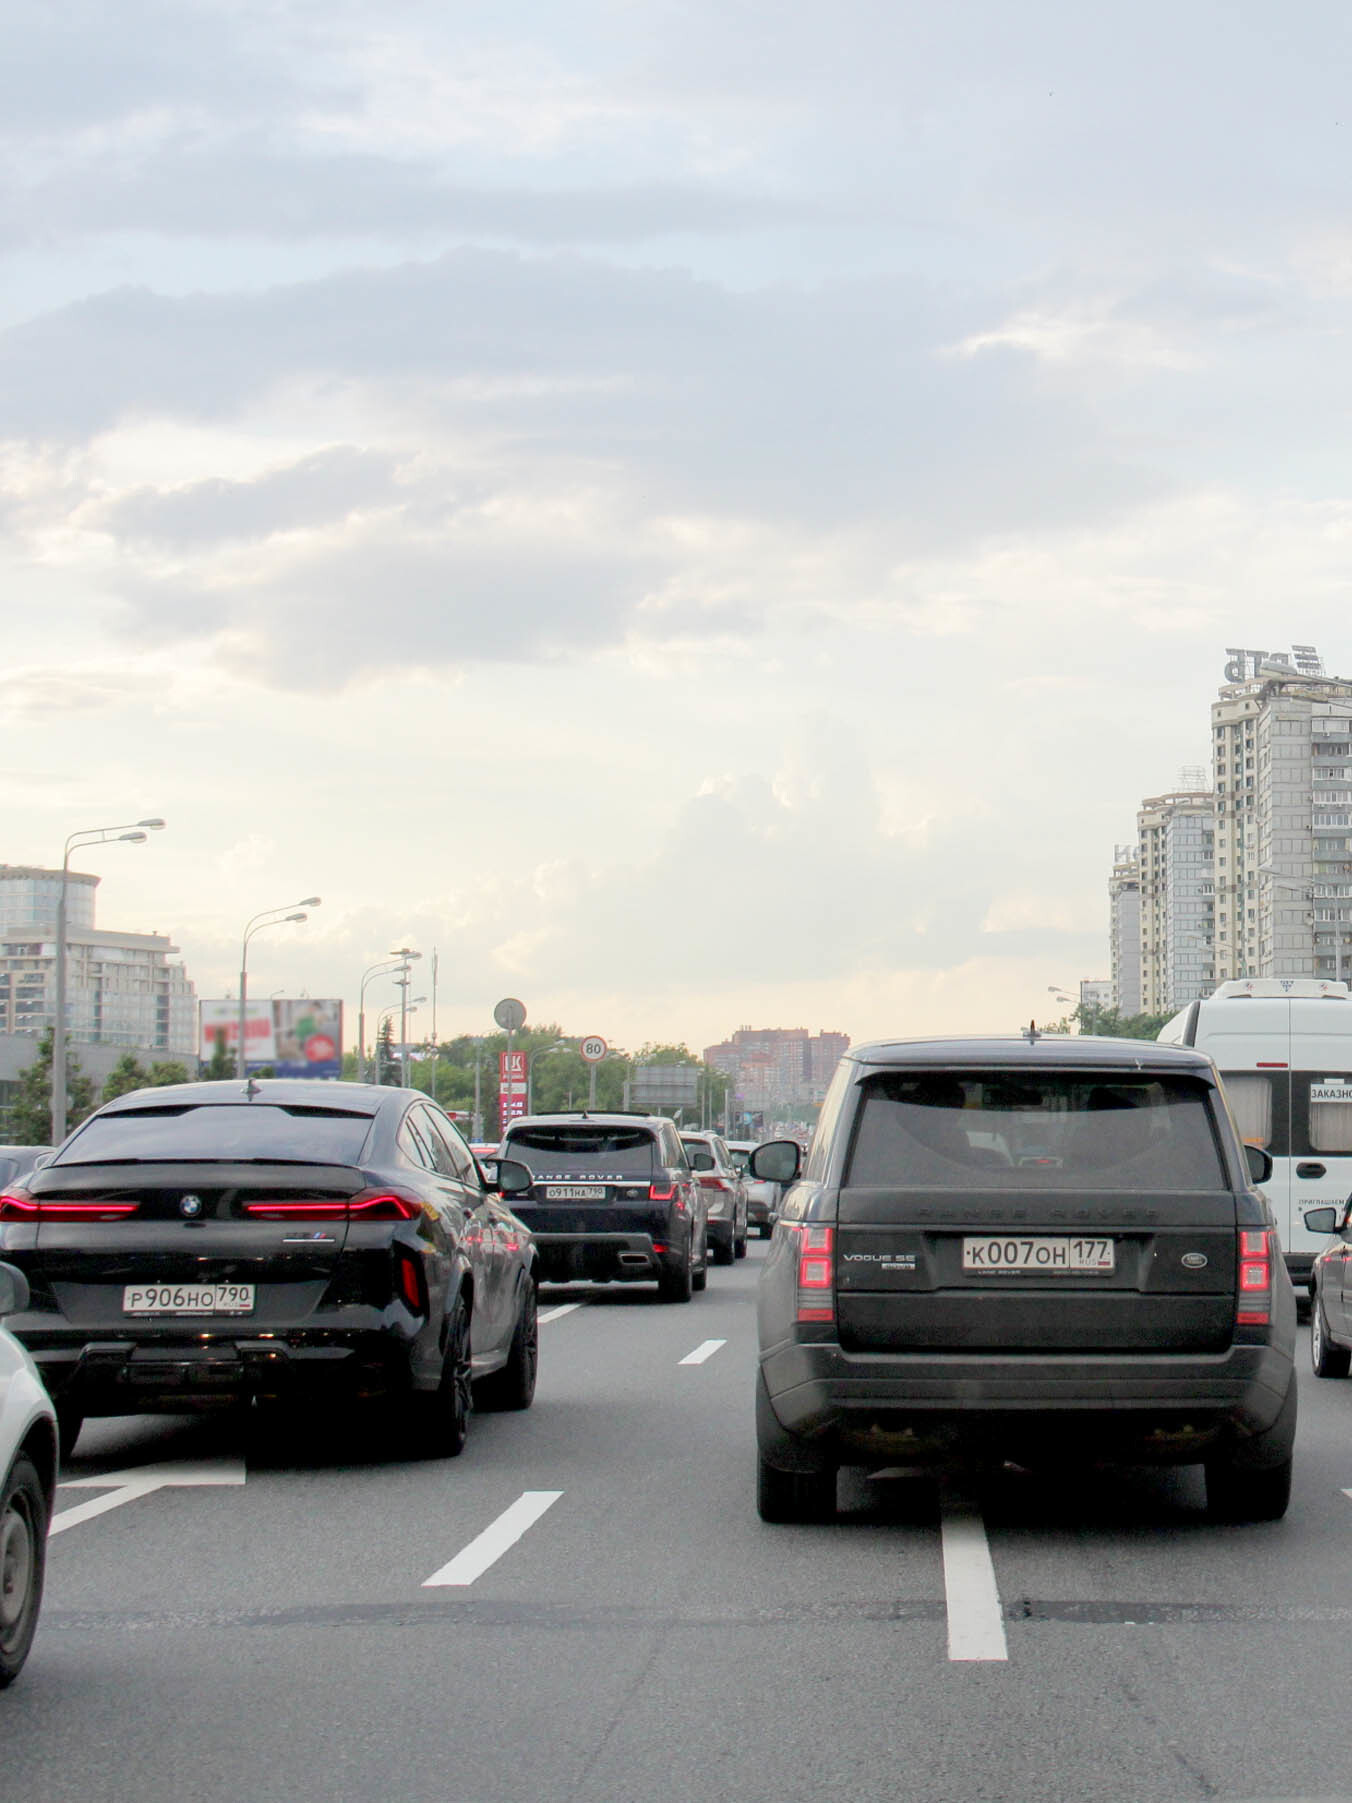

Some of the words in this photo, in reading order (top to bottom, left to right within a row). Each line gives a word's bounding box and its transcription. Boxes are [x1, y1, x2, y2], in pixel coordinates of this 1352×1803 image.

[586, 1043, 601, 1055] 80
[843, 1254, 891, 1262] VOGUE
[895, 1254, 915, 1262] SE
[972, 1241, 1066, 1265] К007ОН
[1073, 1240, 1108, 1259] 177
[131, 1288, 214, 1308] Р906НО
[218, 1287, 249, 1302] 790
